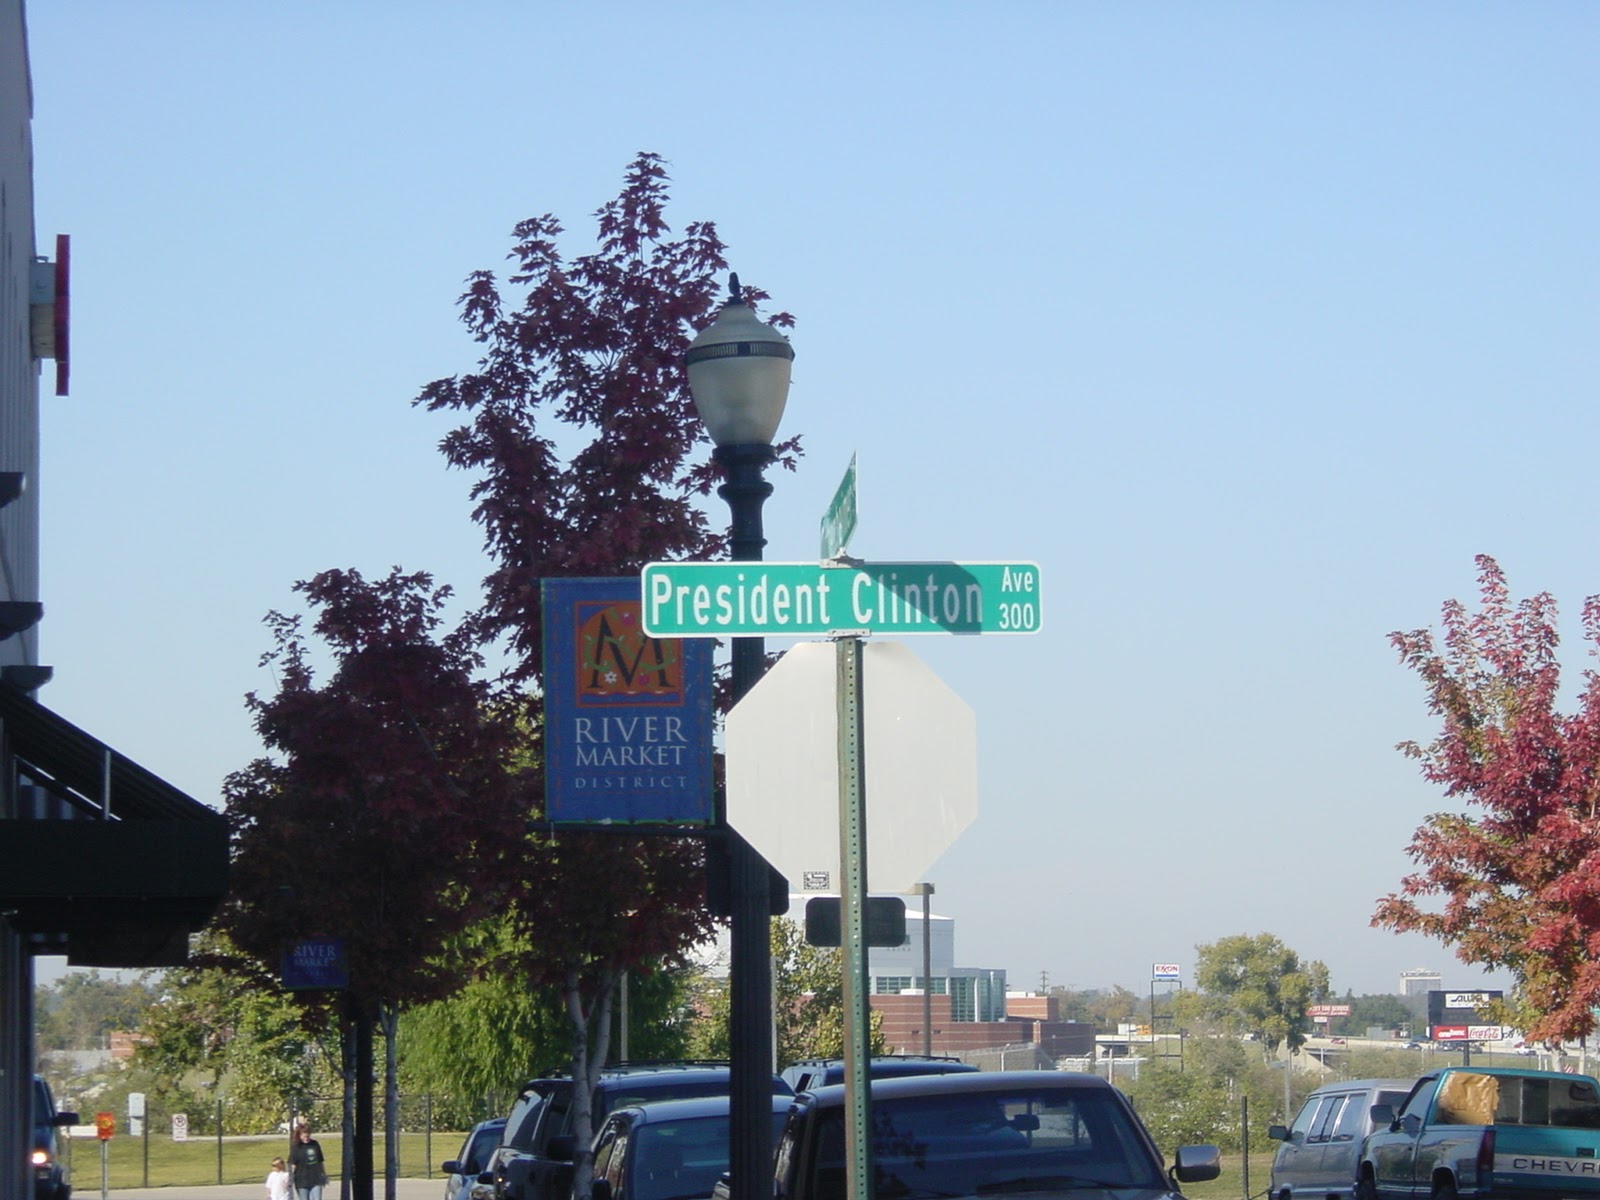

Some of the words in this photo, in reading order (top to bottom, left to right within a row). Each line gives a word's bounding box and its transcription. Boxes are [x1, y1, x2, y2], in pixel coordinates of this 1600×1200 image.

[1001, 566, 1033, 593] Ave
[651, 573, 830, 626] President
[852, 572, 983, 624] Clinton
[998, 603, 1034, 630] 300
[575, 716, 688, 743] RIVER
[575, 745, 687, 767] MARKET
[575, 776, 687, 789] DISTRICT
[1155, 965, 1178, 974] EXXON
[1513, 1158, 1600, 1174] CHEVR
